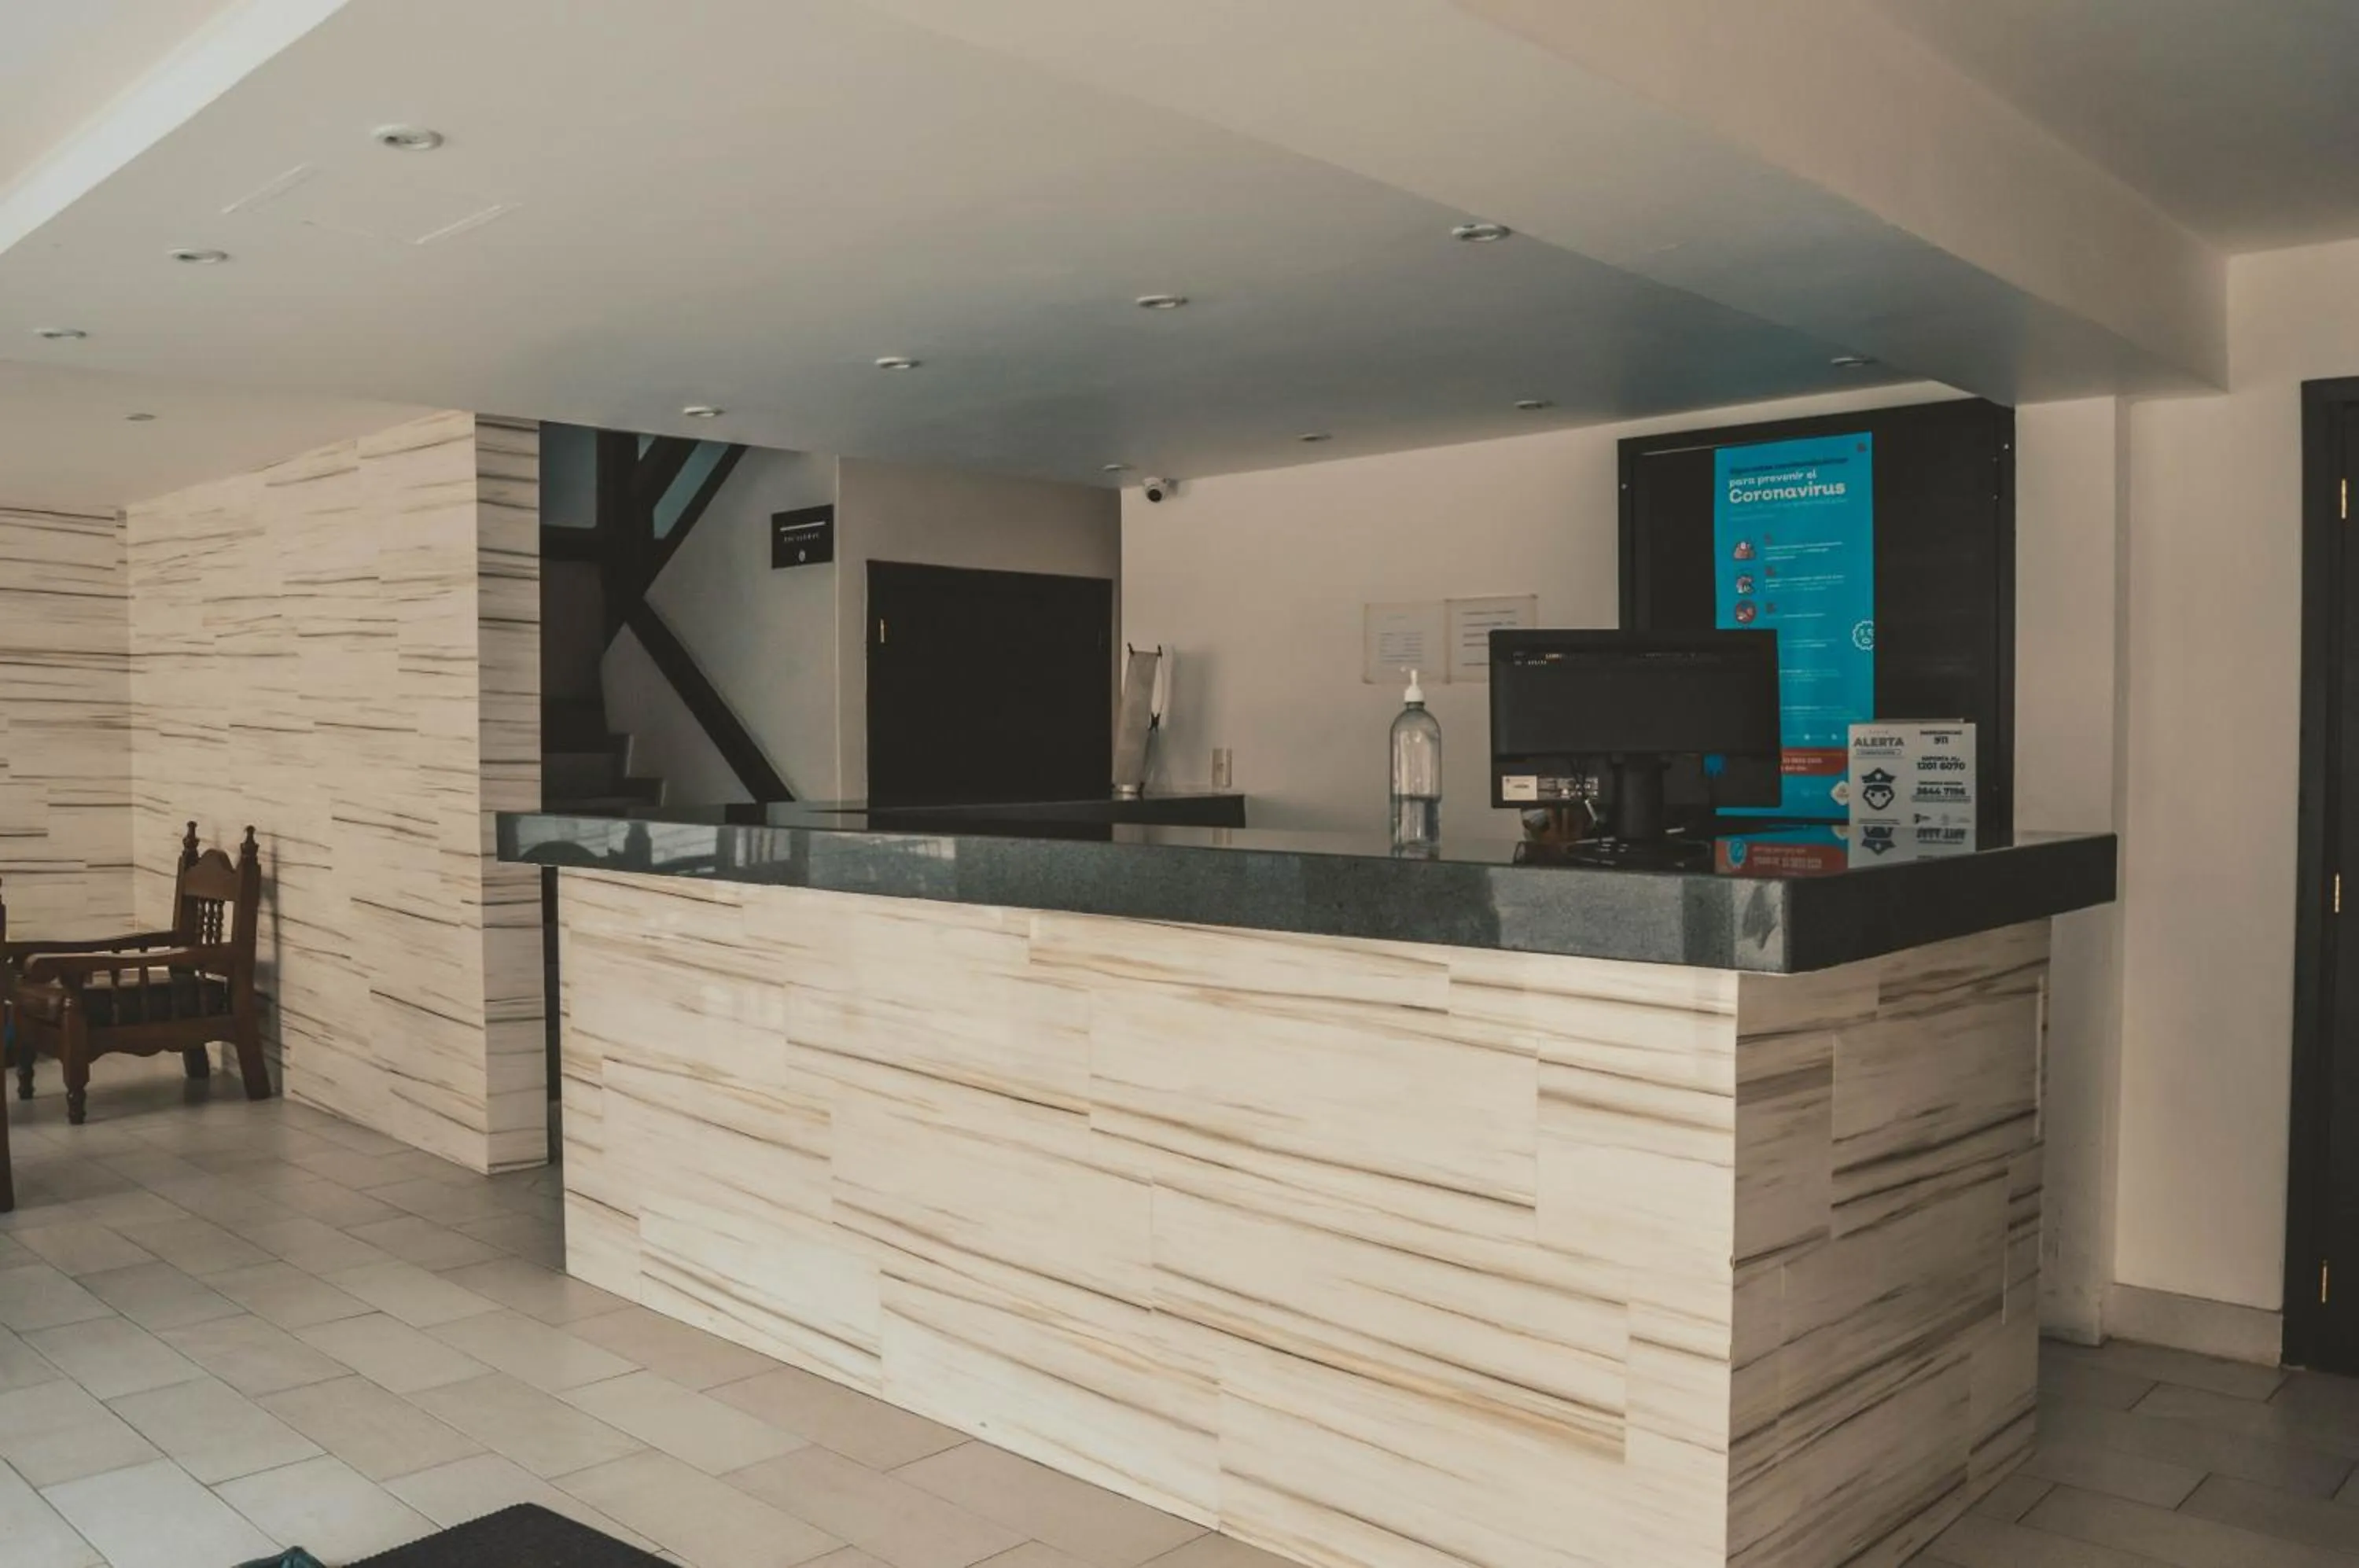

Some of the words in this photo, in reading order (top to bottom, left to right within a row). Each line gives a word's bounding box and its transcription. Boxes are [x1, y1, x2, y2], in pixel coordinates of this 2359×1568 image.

[1728, 478, 1756, 489] para
[1757, 471, 1804, 487] prevenir
[1806, 468, 1817, 480] el
[1729, 480, 1846, 504] Coronavirus
[1853, 736, 1904, 747] ALERTA
